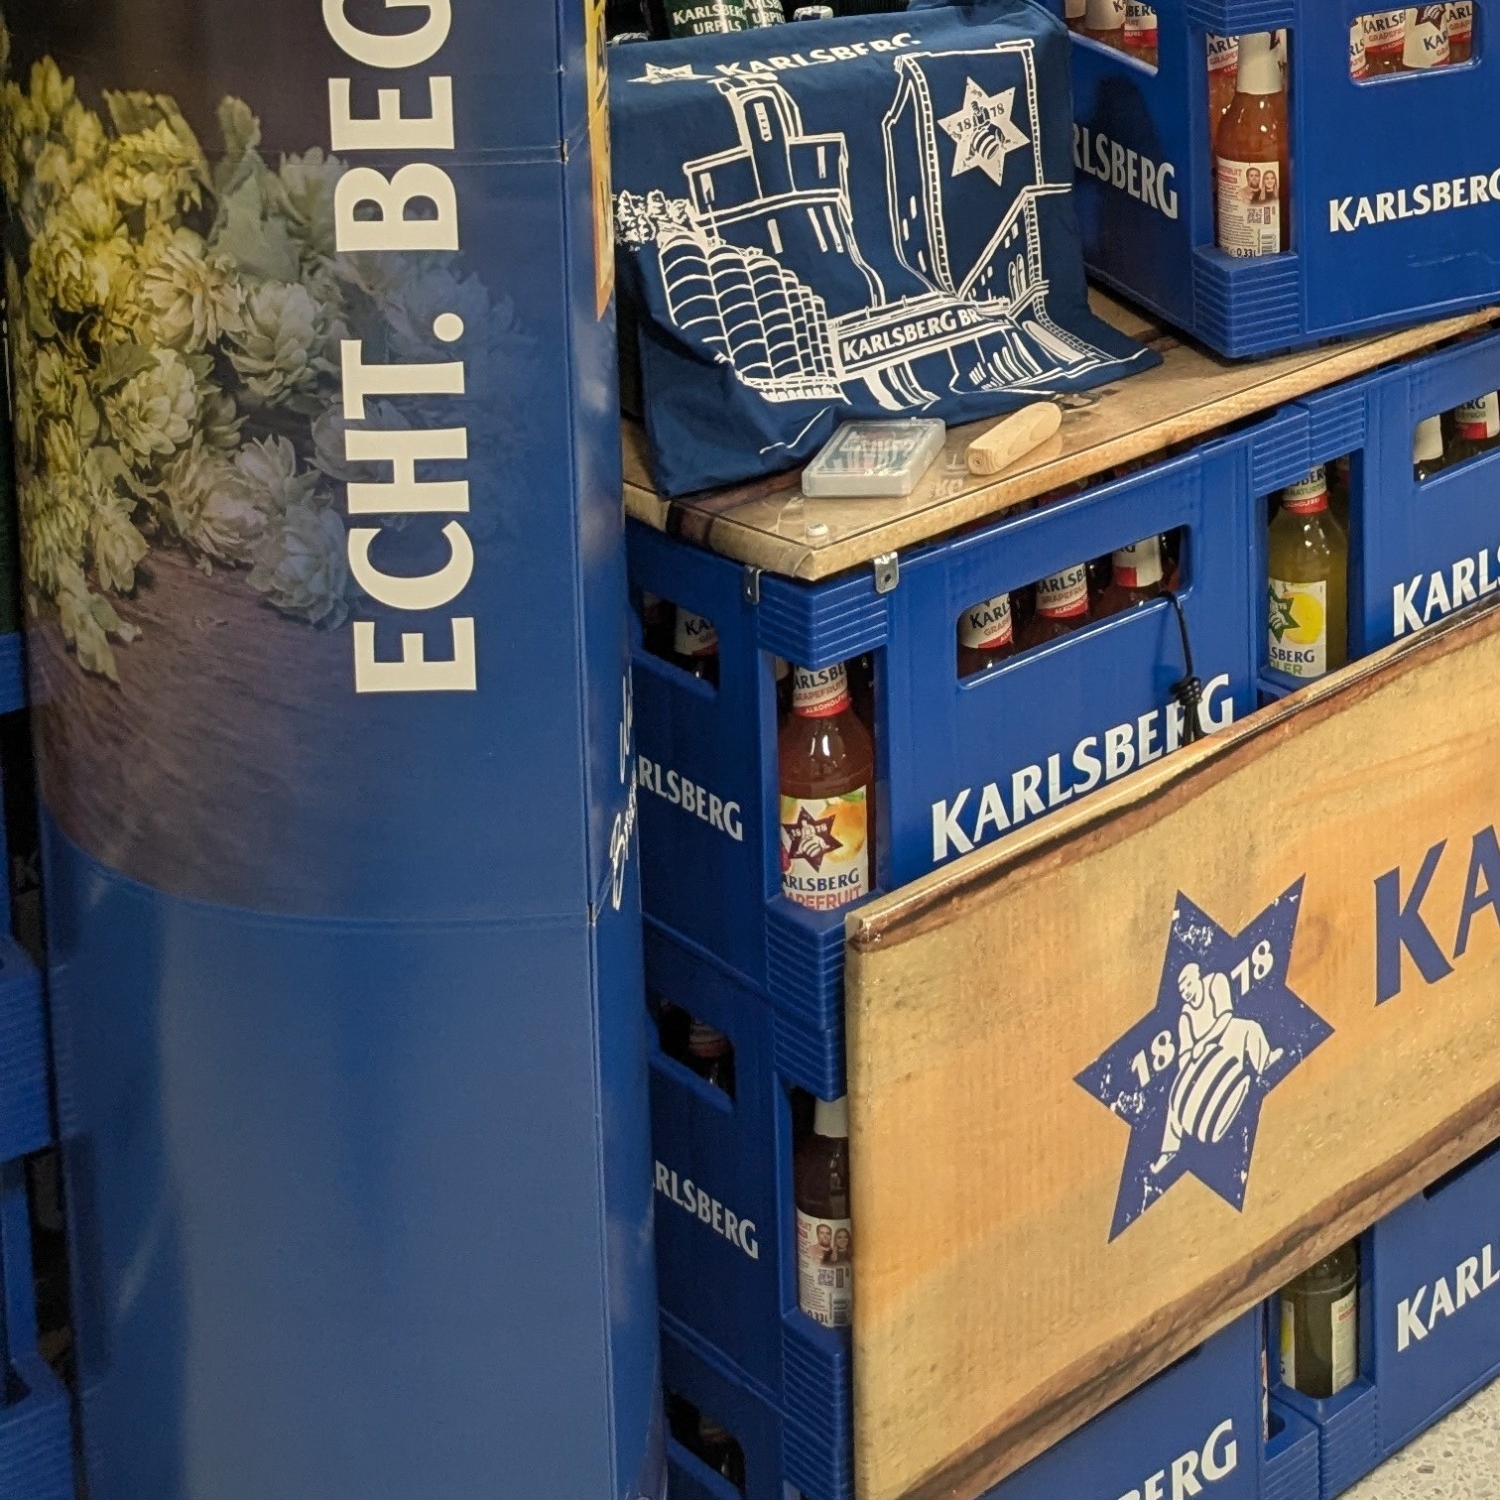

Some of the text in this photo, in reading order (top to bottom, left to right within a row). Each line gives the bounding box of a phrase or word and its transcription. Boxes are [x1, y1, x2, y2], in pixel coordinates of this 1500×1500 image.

[672, 4, 747, 26] KARLSBERG
[693, 20, 742, 36] URPILS
[1071, 121, 1179, 220] RLSBERG
[842, 309, 958, 362] KARLSBERG
[341, 311, 477, 693] ECHT.
[1268, 649, 1315, 664] LSBERG
[637, 754, 743, 842] RLSBERG
[781, 867, 860, 893] ARLSBERG
[1130, 939, 1275, 1088] 18 78
[652, 1159, 760, 1260] RLSBERG
